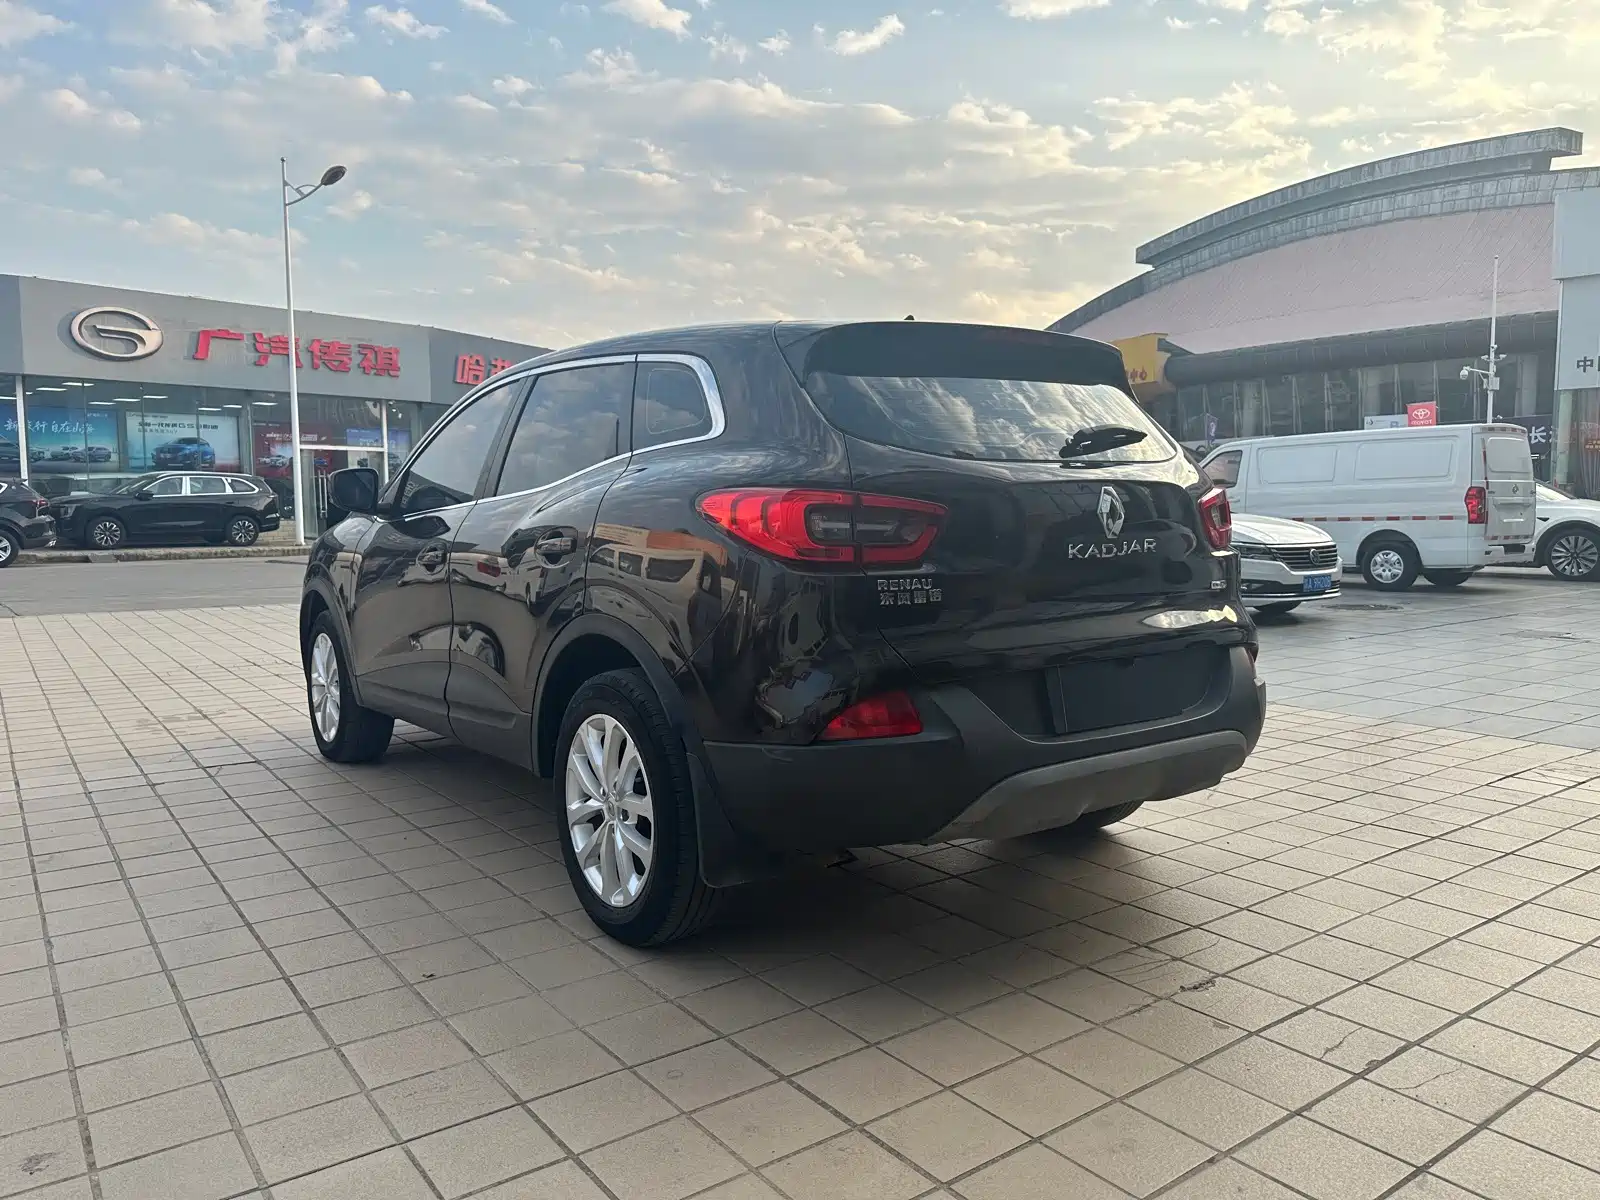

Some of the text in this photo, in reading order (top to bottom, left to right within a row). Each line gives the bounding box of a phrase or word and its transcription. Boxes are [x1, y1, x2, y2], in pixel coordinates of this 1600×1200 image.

[193, 328, 400, 377] 广汽传祺
[1576, 356, 1600, 373] 中
[1529, 425, 1552, 445] 长
[1068, 538, 1157, 559] KADJAR
[877, 578, 933, 591] RENAU
